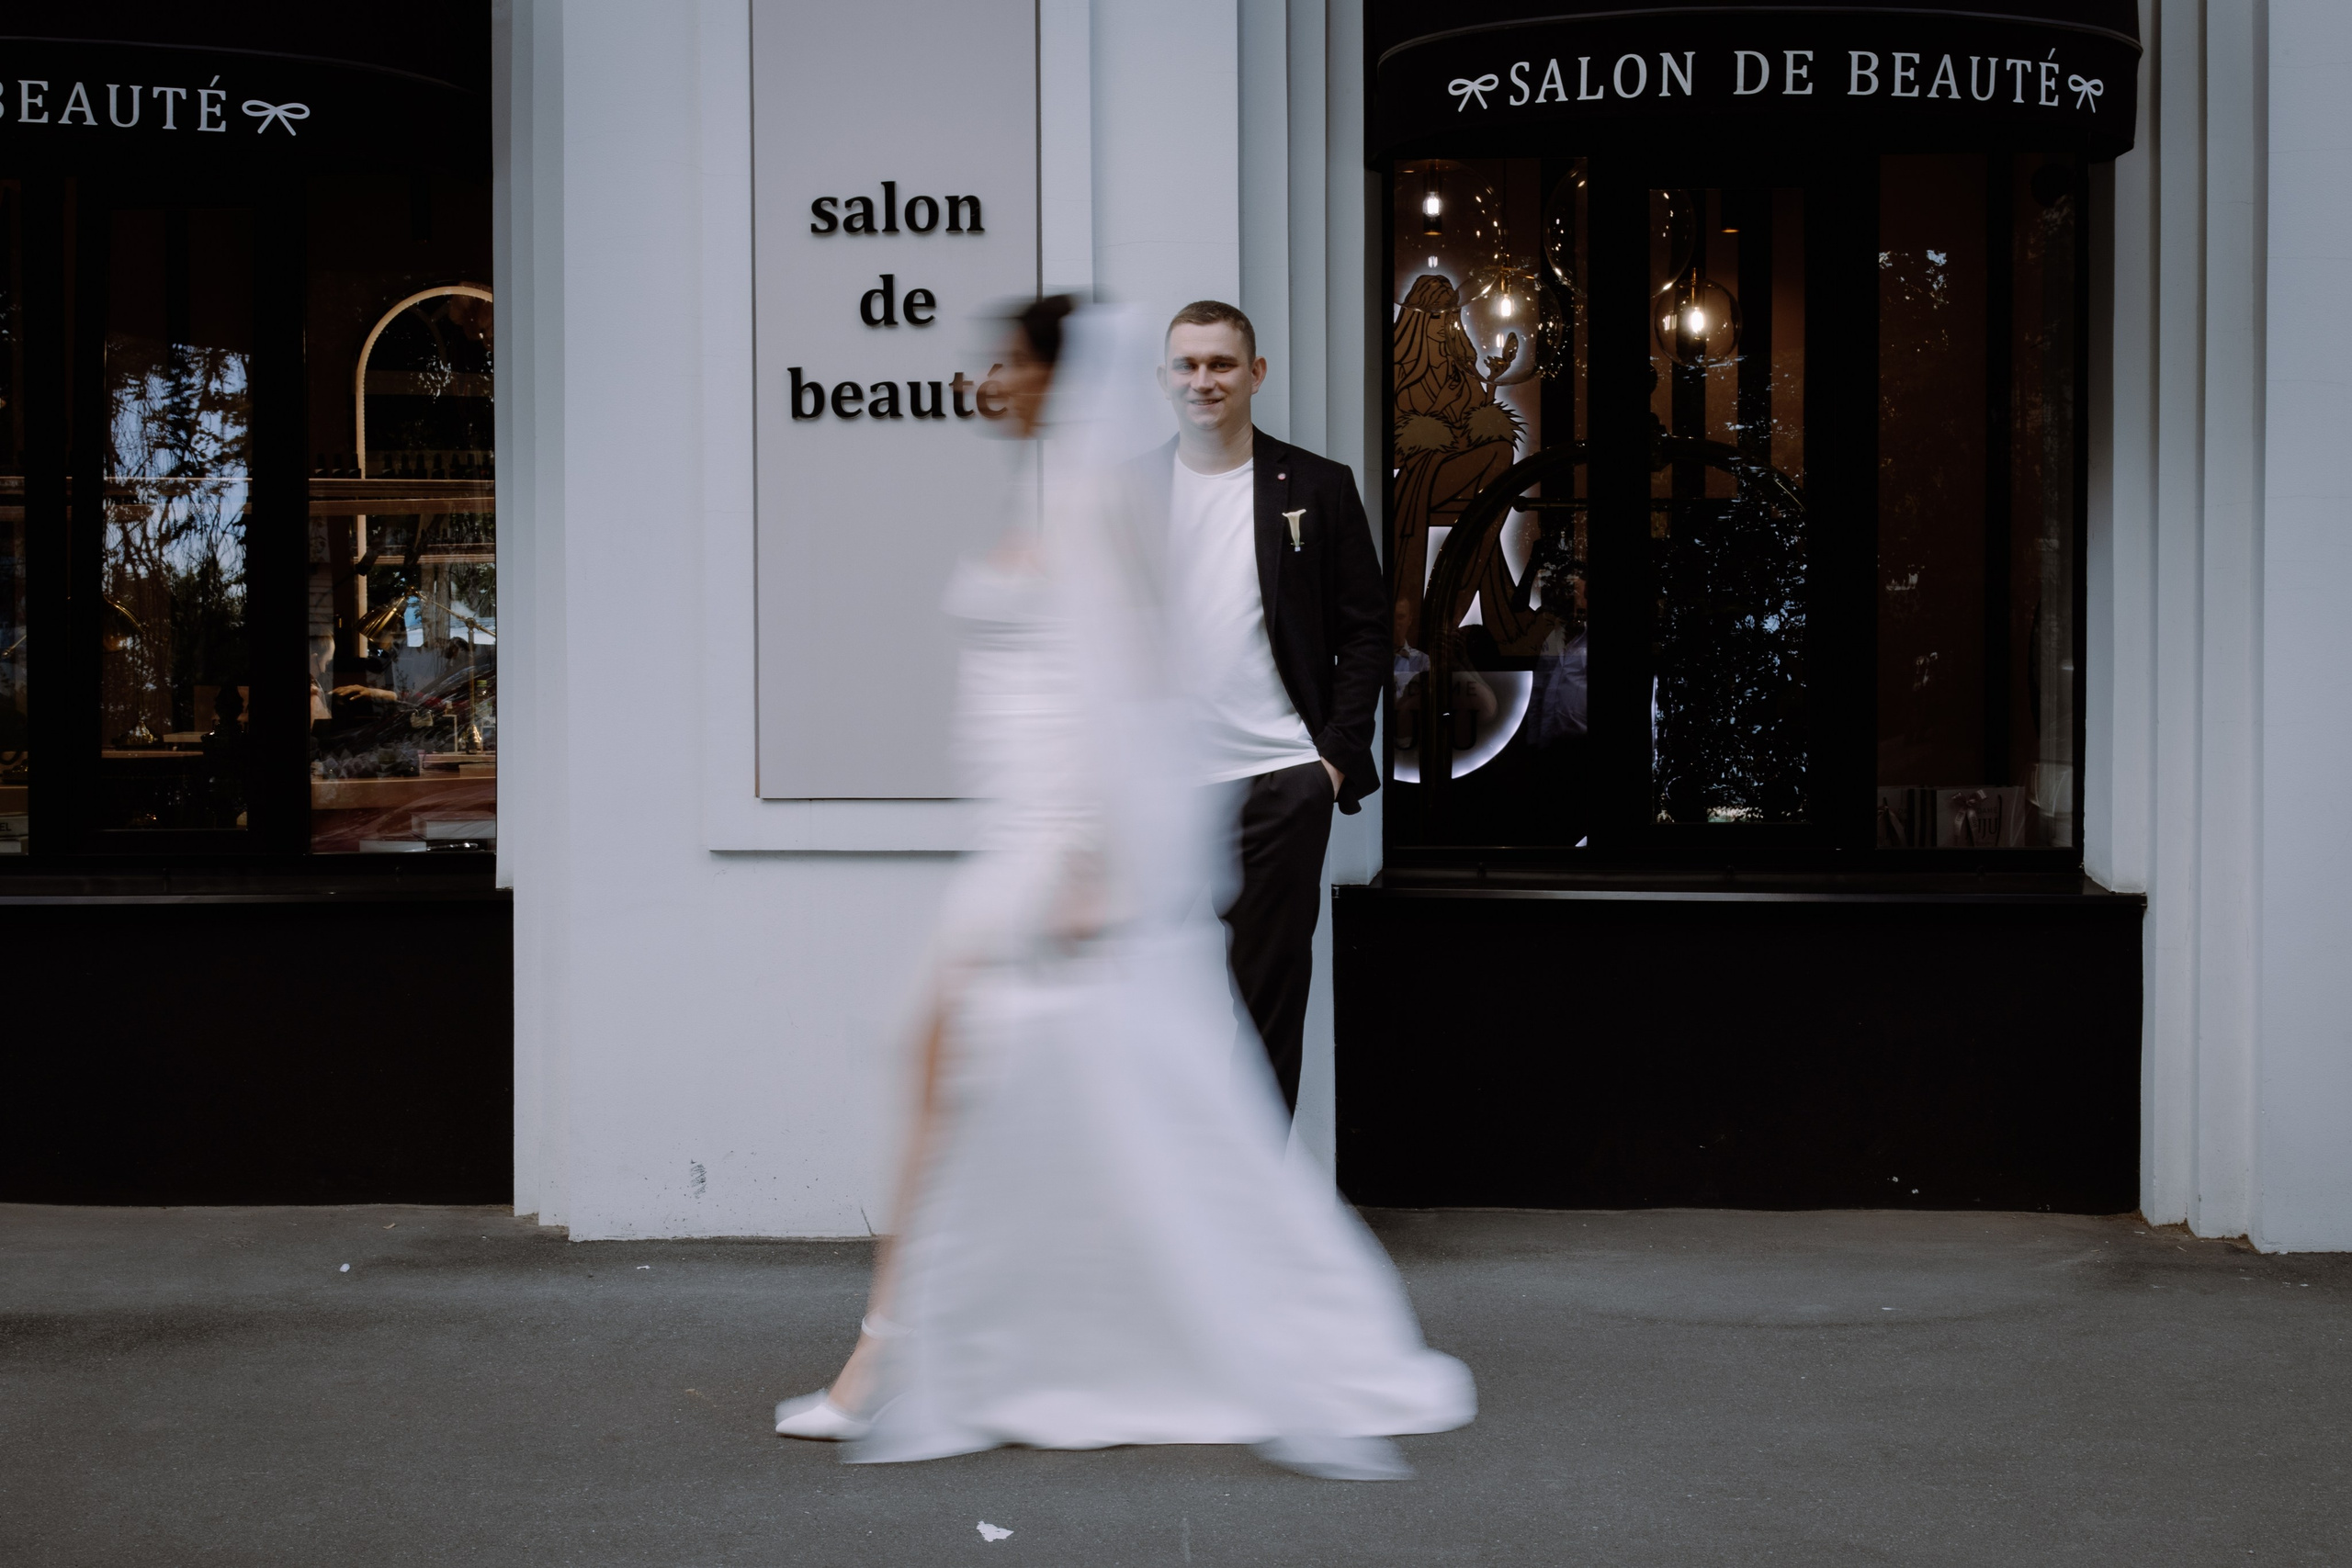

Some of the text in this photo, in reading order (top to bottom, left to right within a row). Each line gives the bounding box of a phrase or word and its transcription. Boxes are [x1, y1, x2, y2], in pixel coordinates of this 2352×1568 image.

[0, 75, 227, 132] EAUTÉ
[1509, 47, 2060, 107] SALON DE BEAUTÉ
[810, 180, 985, 235] salon
[859, 274, 937, 327] de
[786, 363, 1009, 420] beauté
